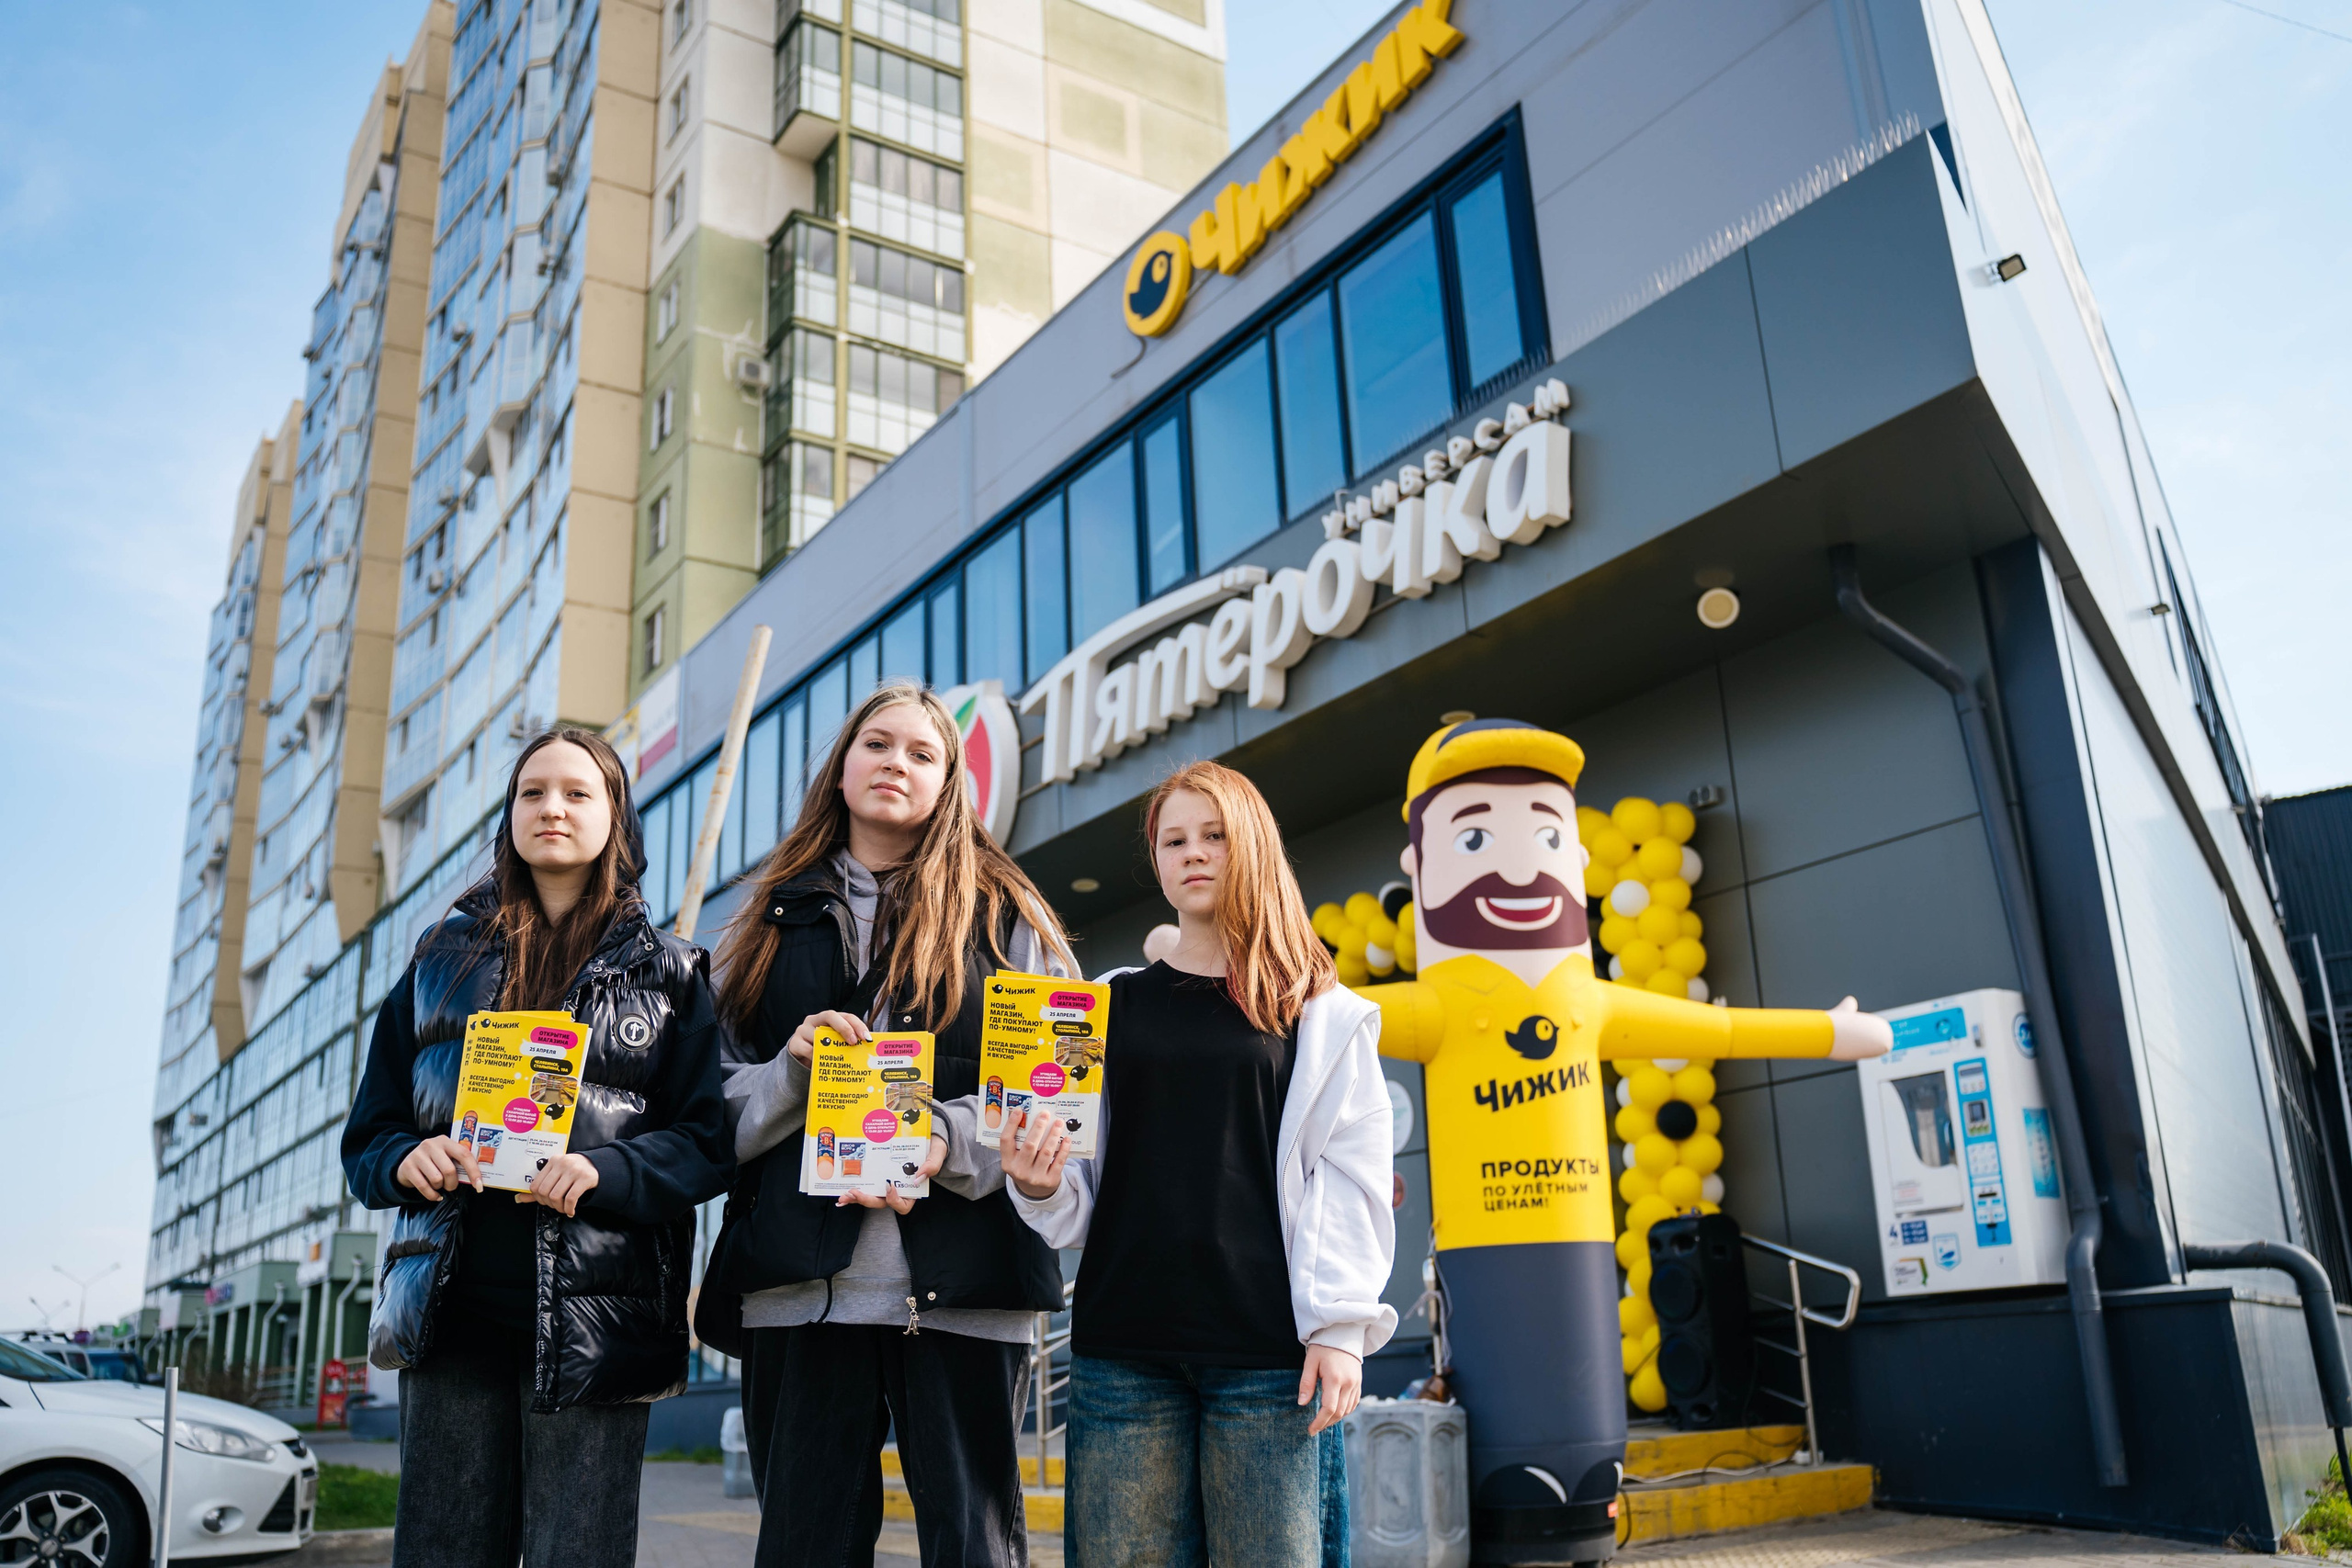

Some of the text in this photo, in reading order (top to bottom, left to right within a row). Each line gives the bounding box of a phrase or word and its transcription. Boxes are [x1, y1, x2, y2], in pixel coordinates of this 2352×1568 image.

[1321, 378, 1570, 540] УНИВЕРСАМ
[990, 1010, 1024, 1019] МАГАЗИН,
[1003, 1018, 1043, 1027] ПОКУПАЮТ
[989, 1024, 1036, 1034] ПО-УМНОМУ!
[538, 1037, 568, 1045] МАГАЗИНА
[476, 1044, 506, 1053] МАГАЗИН,
[987, 1047, 1027, 1055] КАЧЕСТВЕННО
[486, 1052, 522, 1061] ПОКУПАЮТ
[473, 1058, 515, 1068] ПО-УМНОМУ!
[468, 1081, 504, 1089] КАЧЕСТВЕННО
[1481, 1158, 1600, 1179] ПРОДУКТЫ
[1484, 1182, 1588, 1198] ПО УЛЁТНЫМ
[1485, 1198, 1549, 1212] ЦЕНАМ!
